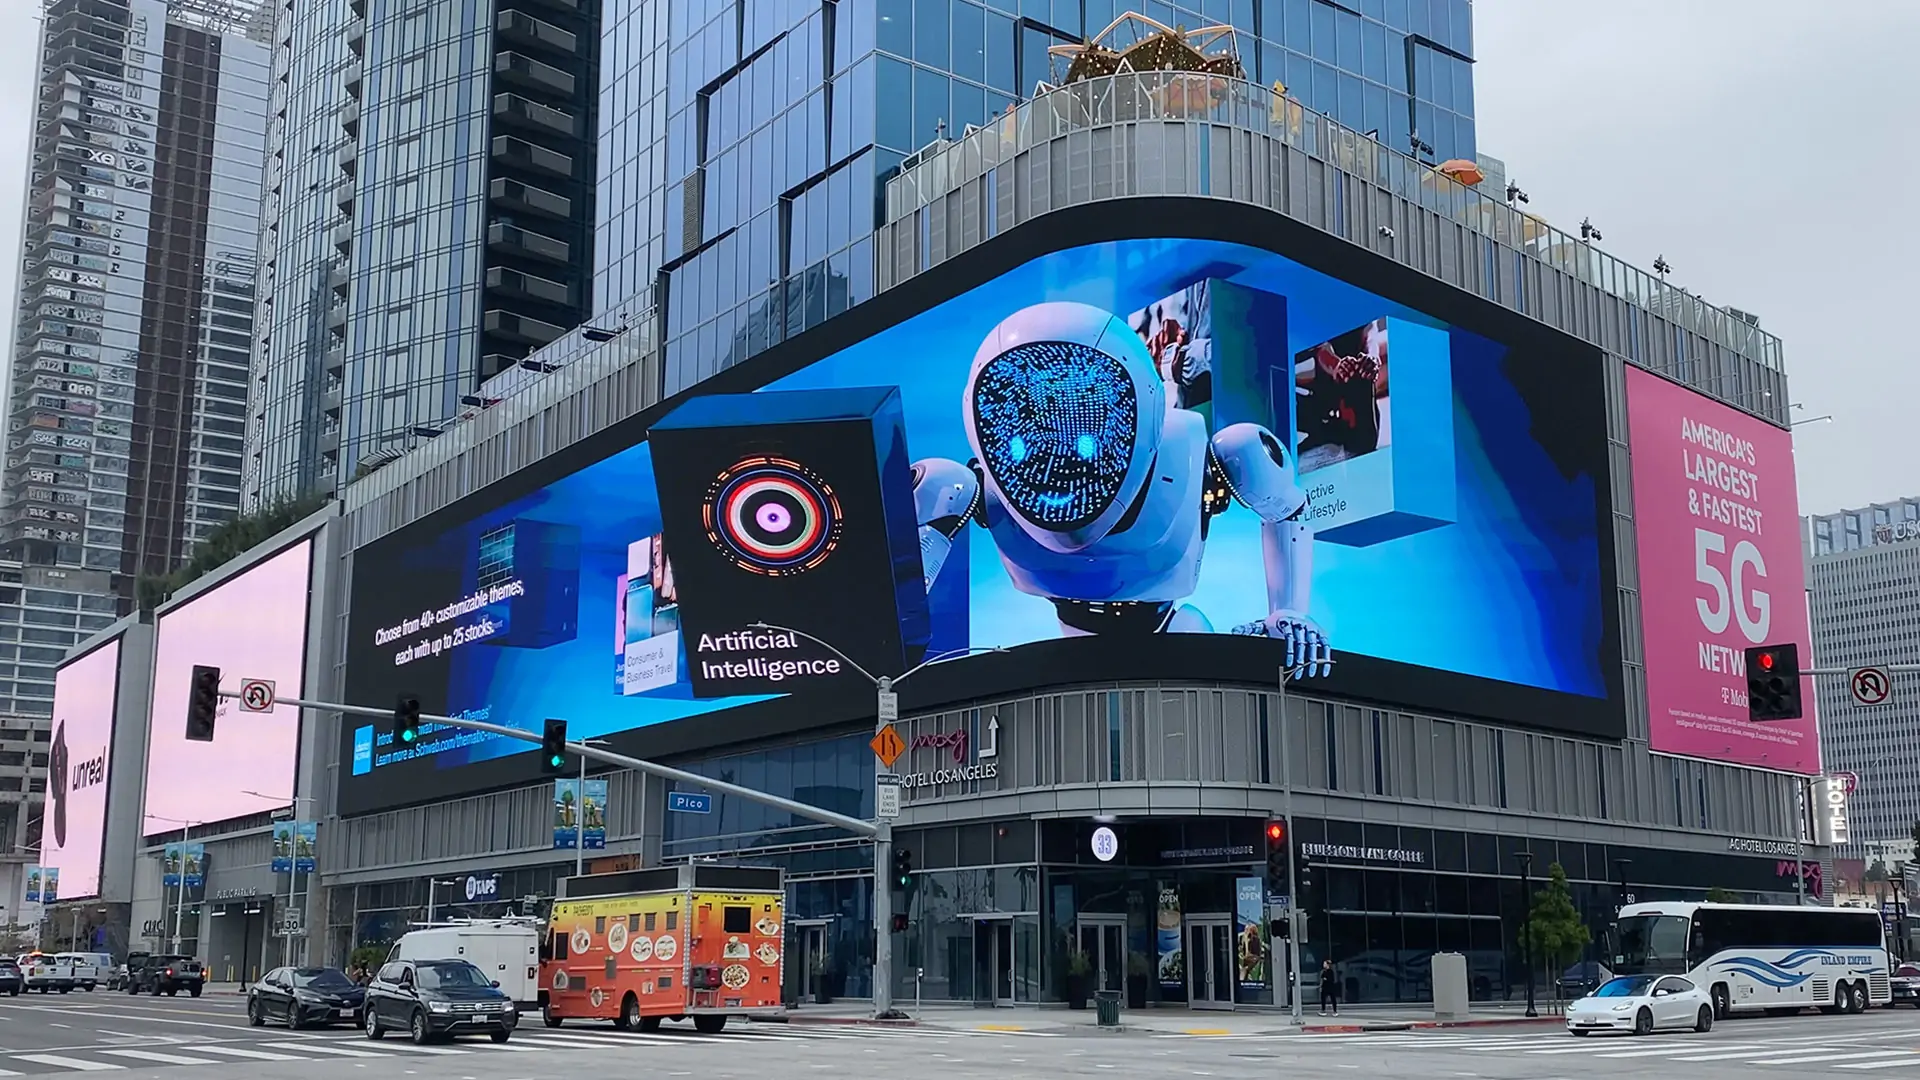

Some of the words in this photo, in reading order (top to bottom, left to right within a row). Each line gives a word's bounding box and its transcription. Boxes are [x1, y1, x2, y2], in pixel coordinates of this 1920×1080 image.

[1682, 417, 1755, 466] AMERICA'S
[1683, 448, 1758, 502] LARGEST
[1306, 484, 1334, 500] ctive
[1304, 499, 1346, 521] Lifestyle
[1689, 488, 1700, 516] &
[1702, 492, 1762, 535] FASTEST
[1895, 520, 1920, 539] US
[1695, 528, 1770, 643] 5G
[375, 626, 401, 646] Choose
[402, 619, 419, 637] from
[420, 610, 434, 629] 40+
[436, 591, 488, 623] customizable
[489, 580, 525, 604] themes,
[395, 644, 413, 665] each
[414, 638, 430, 659] with
[431, 639, 442, 656] up
[443, 634, 451, 649] to
[453, 627, 465, 646] 25
[465, 619, 494, 642] stocks.
[698, 630, 798, 652] Artificial
[627, 651, 657, 668] Consumer
[702, 657, 840, 681] Intelligence
[1698, 641, 1746, 678] NETW
[627, 668, 653, 683] Business
[655, 661, 673, 675] Travel
[1731, 689, 1749, 709] Mob
[911, 729, 965, 763] moxy
[73, 745, 105, 791] unreal
[375, 753, 391, 767] Learn
[392, 750, 407, 763] more
[931, 769, 950, 784] LOS
[950, 763, 996, 783] ANGELES
[677, 797, 703, 808] Pico
[1827, 778, 1847, 843] HOTEL
[1098, 834, 1111, 854] 33
[1361, 847, 1387, 860] LANE
[1729, 838, 1740, 850] AC
[1741, 840, 1763, 853] HOTEL
[1764, 842, 1777, 853] LOS
[1777, 844, 1804, 856] ANGELS
[477, 879, 496, 895] TAPS
[1240, 892, 1260, 900] OPEN
[1159, 894, 1178, 903] OPEN
[1627, 894, 1635, 903] 60
[286, 921, 298, 929] 30
[1821, 956, 1845, 965] INLAND
[1848, 956, 1872, 965] EMPIRE
